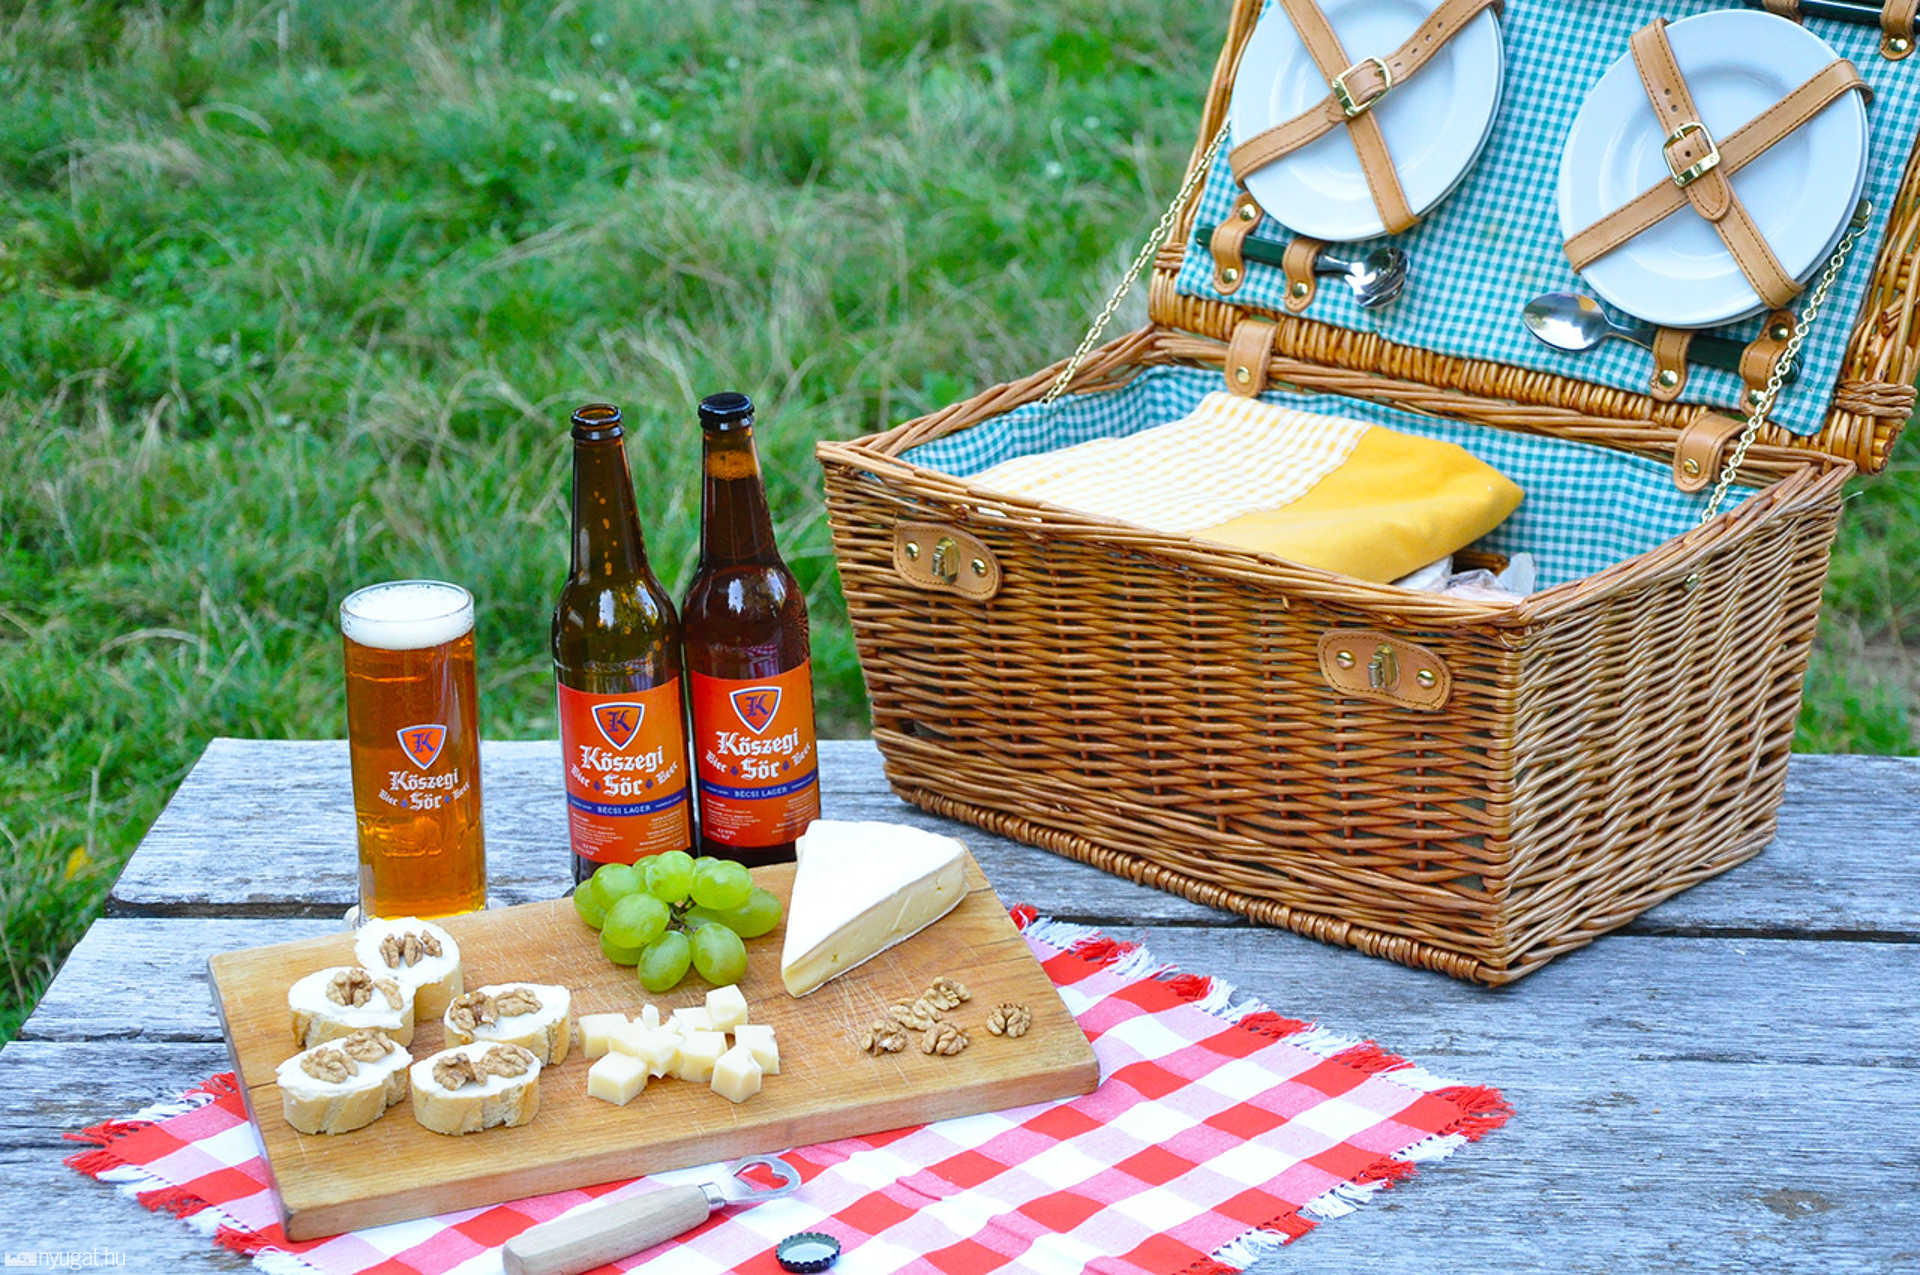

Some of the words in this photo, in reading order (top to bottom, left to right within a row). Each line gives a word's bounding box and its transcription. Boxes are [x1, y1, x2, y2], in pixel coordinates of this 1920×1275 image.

[746, 694, 768, 717] K
[607, 710, 632, 732] K
[412, 731, 435, 753] K
[740, 757, 780, 780] Sör
[602, 773, 643, 797] Sör
[761, 785, 788, 798] LAGER
[409, 792, 443, 812] Sör
[623, 804, 651, 815] LAGER
